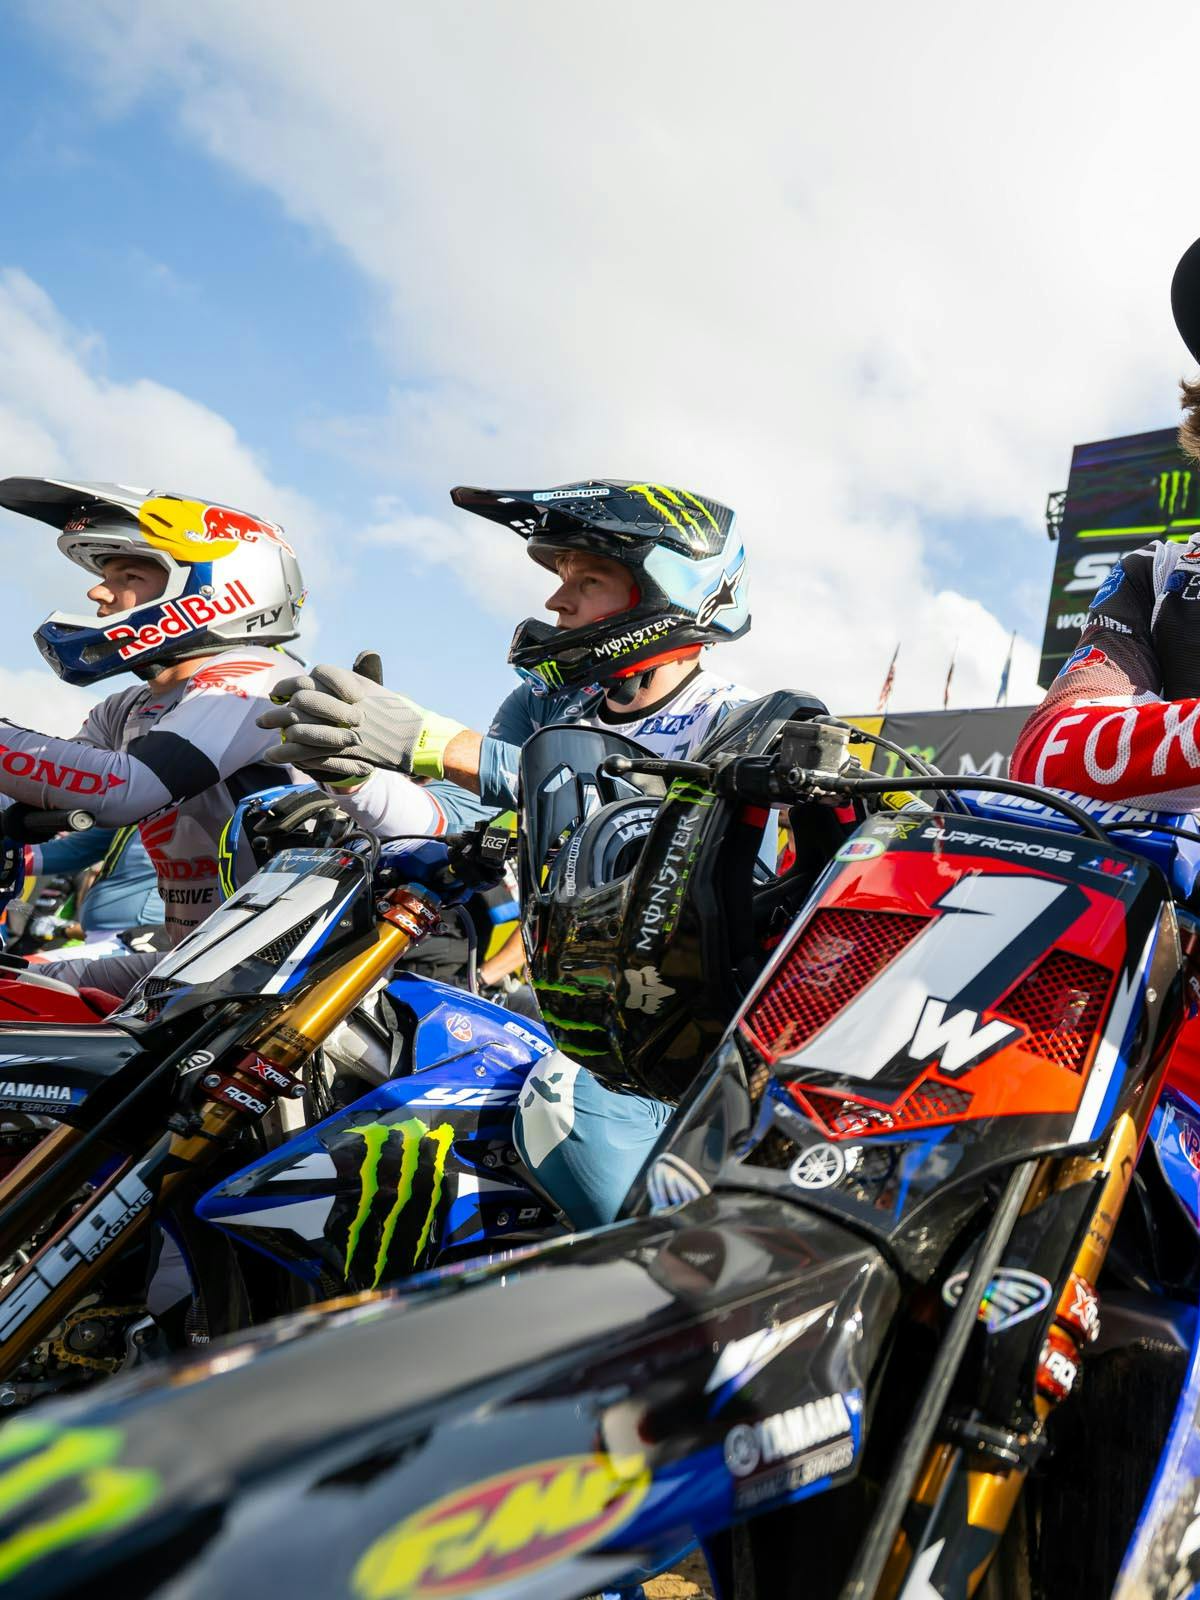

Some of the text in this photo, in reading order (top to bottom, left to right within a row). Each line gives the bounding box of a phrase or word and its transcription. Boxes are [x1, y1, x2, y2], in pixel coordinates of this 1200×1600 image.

[105, 579, 256, 660] Red Bull
[246, 606, 283, 634] FLY
[594, 617, 677, 657] MONSTER
[612, 630, 668, 658] ENERGY
[921, 827, 1076, 863] SUPERCROSS
[249, 1056, 291, 1088] XTRIG
[224, 1086, 267, 1114] ROCS
[86, 1189, 154, 1262] RACING
[191, 1334, 210, 1344] Twin
